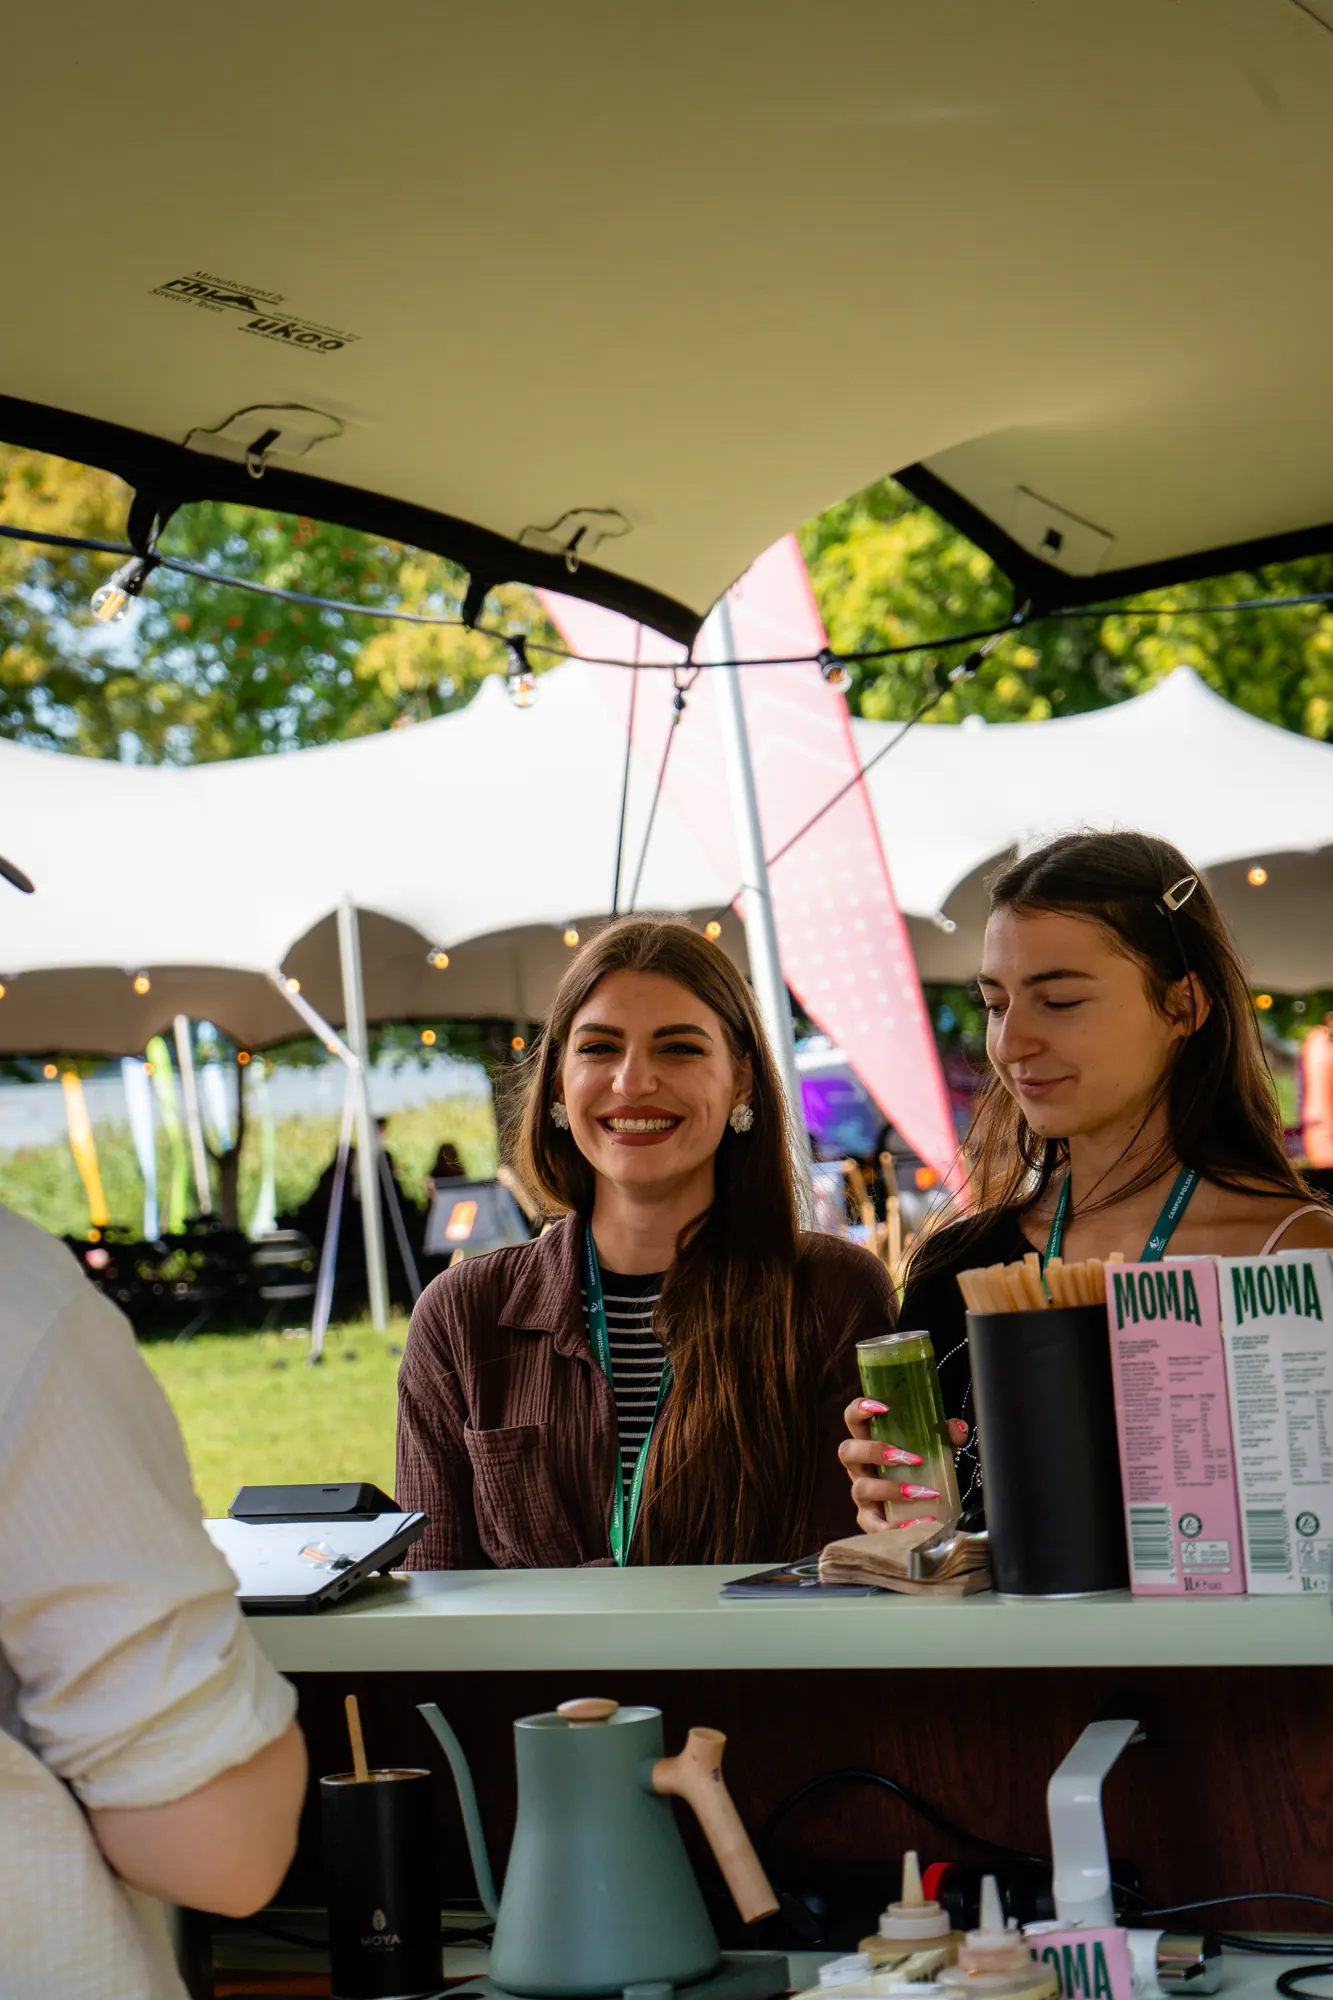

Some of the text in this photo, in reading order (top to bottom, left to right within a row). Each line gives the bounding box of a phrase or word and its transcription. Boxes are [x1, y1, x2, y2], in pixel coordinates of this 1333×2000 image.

[1168, 1174, 1195, 1219] CAMPUS POLSKA
[1112, 1269, 1203, 1331] MOMA
[1231, 1263, 1324, 1326] MOMA
[1030, 1942, 1115, 2000] OMA
